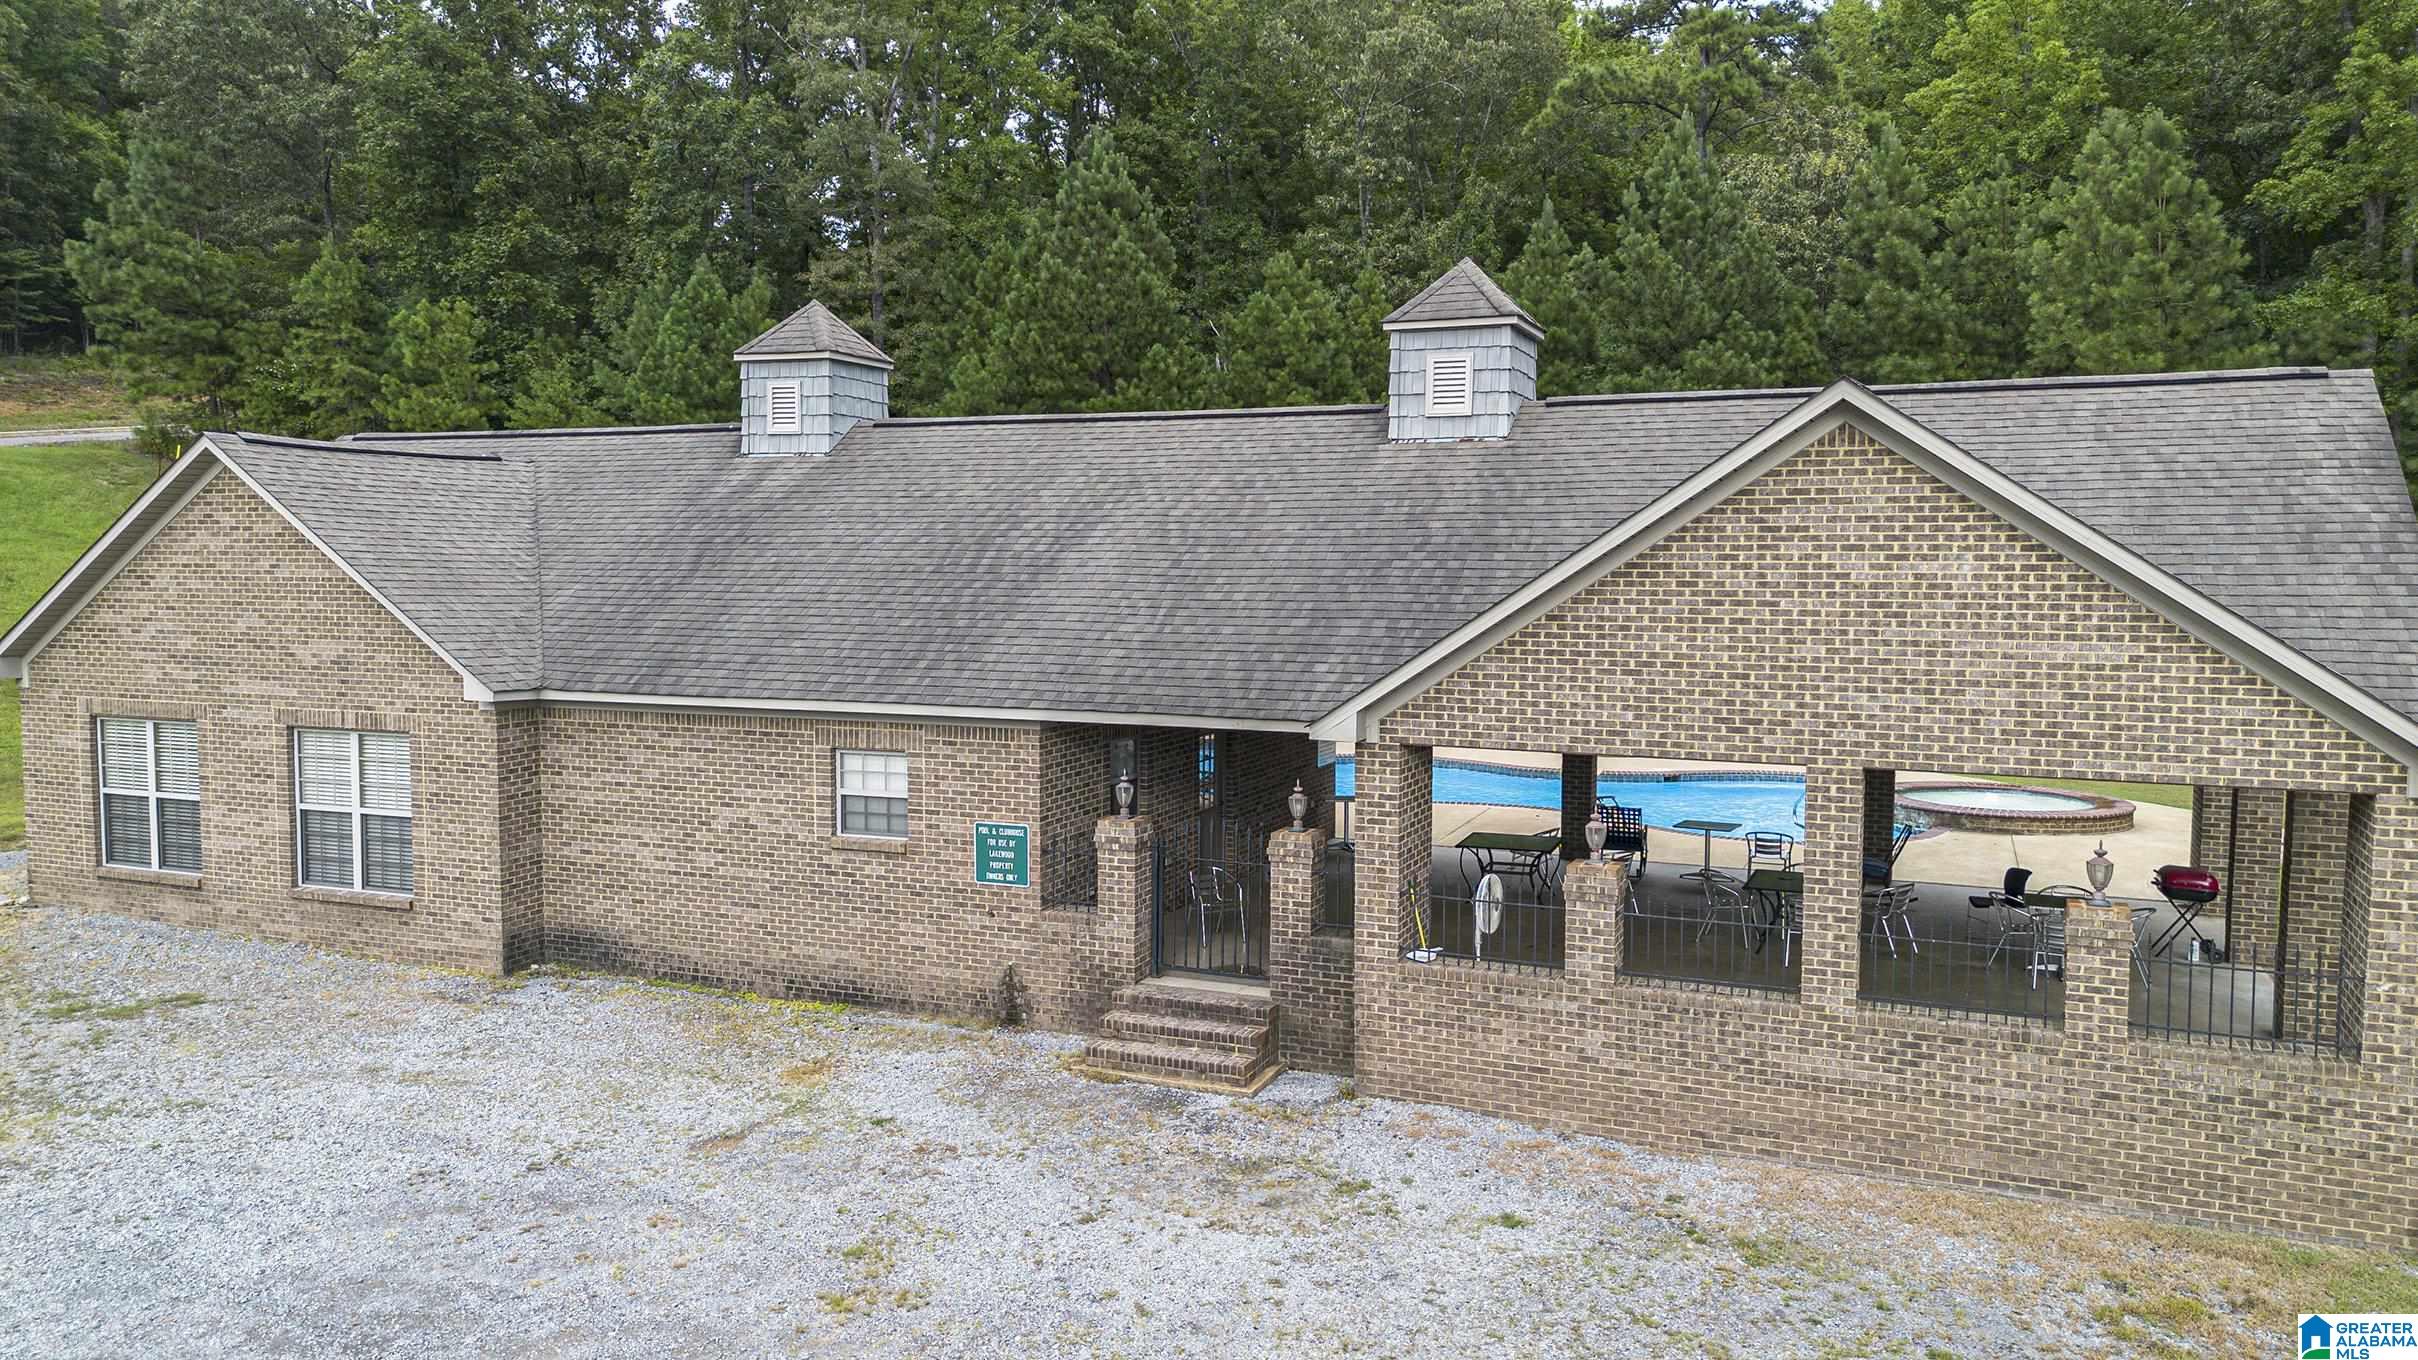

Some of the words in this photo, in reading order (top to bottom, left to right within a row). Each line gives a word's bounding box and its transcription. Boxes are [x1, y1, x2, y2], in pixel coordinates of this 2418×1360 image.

[999, 828, 1024, 837] CLUBHOUSE
[989, 850, 1014, 858] LAKEWOOD
[989, 861, 1013, 870] PROPERTY
[986, 872, 1004, 880] OWNERS
